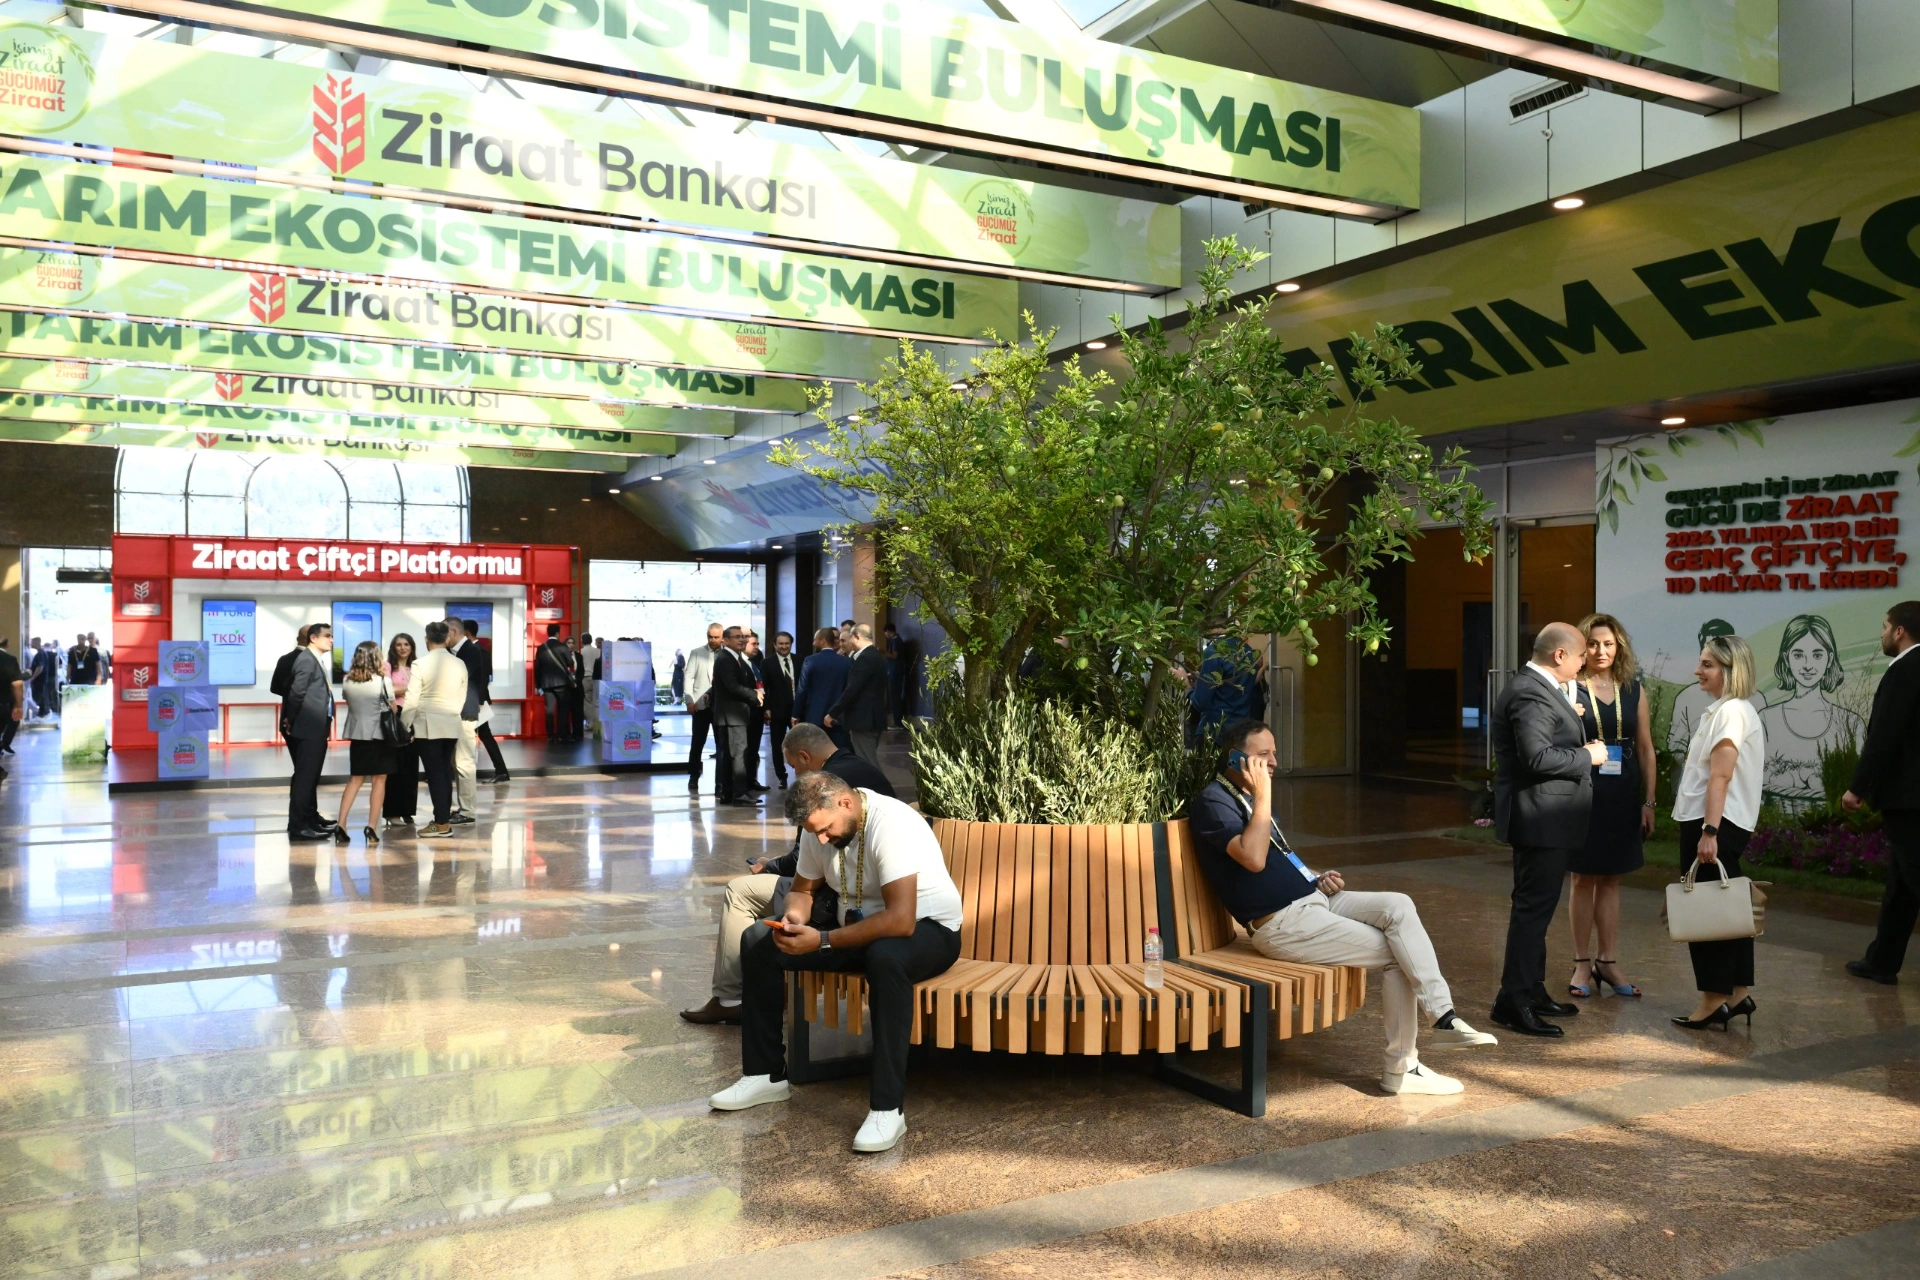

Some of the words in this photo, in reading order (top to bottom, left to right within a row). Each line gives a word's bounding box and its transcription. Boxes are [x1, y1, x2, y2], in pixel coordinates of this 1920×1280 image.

[0, 51, 65, 75] Ziraat
[0, 88, 66, 112] Ziraat
[426, 0, 902, 91] STEMİ
[931, 35, 1341, 173] BULUŞMASI
[381, 108, 582, 187] Ziraat
[598, 142, 816, 219] Bankası
[976, 213, 1017, 232] GÜCÜMÜZ
[977, 200, 1017, 217] Ziraat
[0, 167, 206, 237] ARIM
[230, 194, 626, 284] EKOSİSTEMİ
[647, 246, 955, 319] BULUŞMASI
[977, 228, 1017, 245] Ziraat
[37, 277, 83, 291] Ziraat
[297, 278, 440, 326] Ziraat
[451, 293, 612, 341] Bankası
[736, 344, 767, 355] Ziraat
[1665, 482, 1762, 504] GENÇLERİN
[1765, 476, 1789, 499] İŞİ
[1792, 478, 1820, 494] DE
[1822, 470, 1899, 491] ZİRAAT
[1665, 499, 1737, 528] GÜCÜ
[1742, 501, 1781, 523] DE
[1786, 491, 1899, 520] ZİRAAT
[1665, 530, 1716, 547] 2024
[1718, 524, 1807, 545] YILINDA
[1810, 521, 1851, 540] 160
[1855, 517, 1899, 537] BİN
[192, 543, 290, 571] Ziraat
[297, 546, 375, 576] Çiftçi
[380, 549, 522, 576] Platformu
[1665, 547, 1744, 574] GENÇ
[1751, 537, 1907, 573] ÇİFTÇİYE,
[1665, 577, 1696, 594] 119
[1699, 573, 1782, 592] MİLYAR
[1785, 573, 1816, 590] TL
[1819, 567, 1898, 589] KREDİ
[212, 633, 246, 644] TKDK
